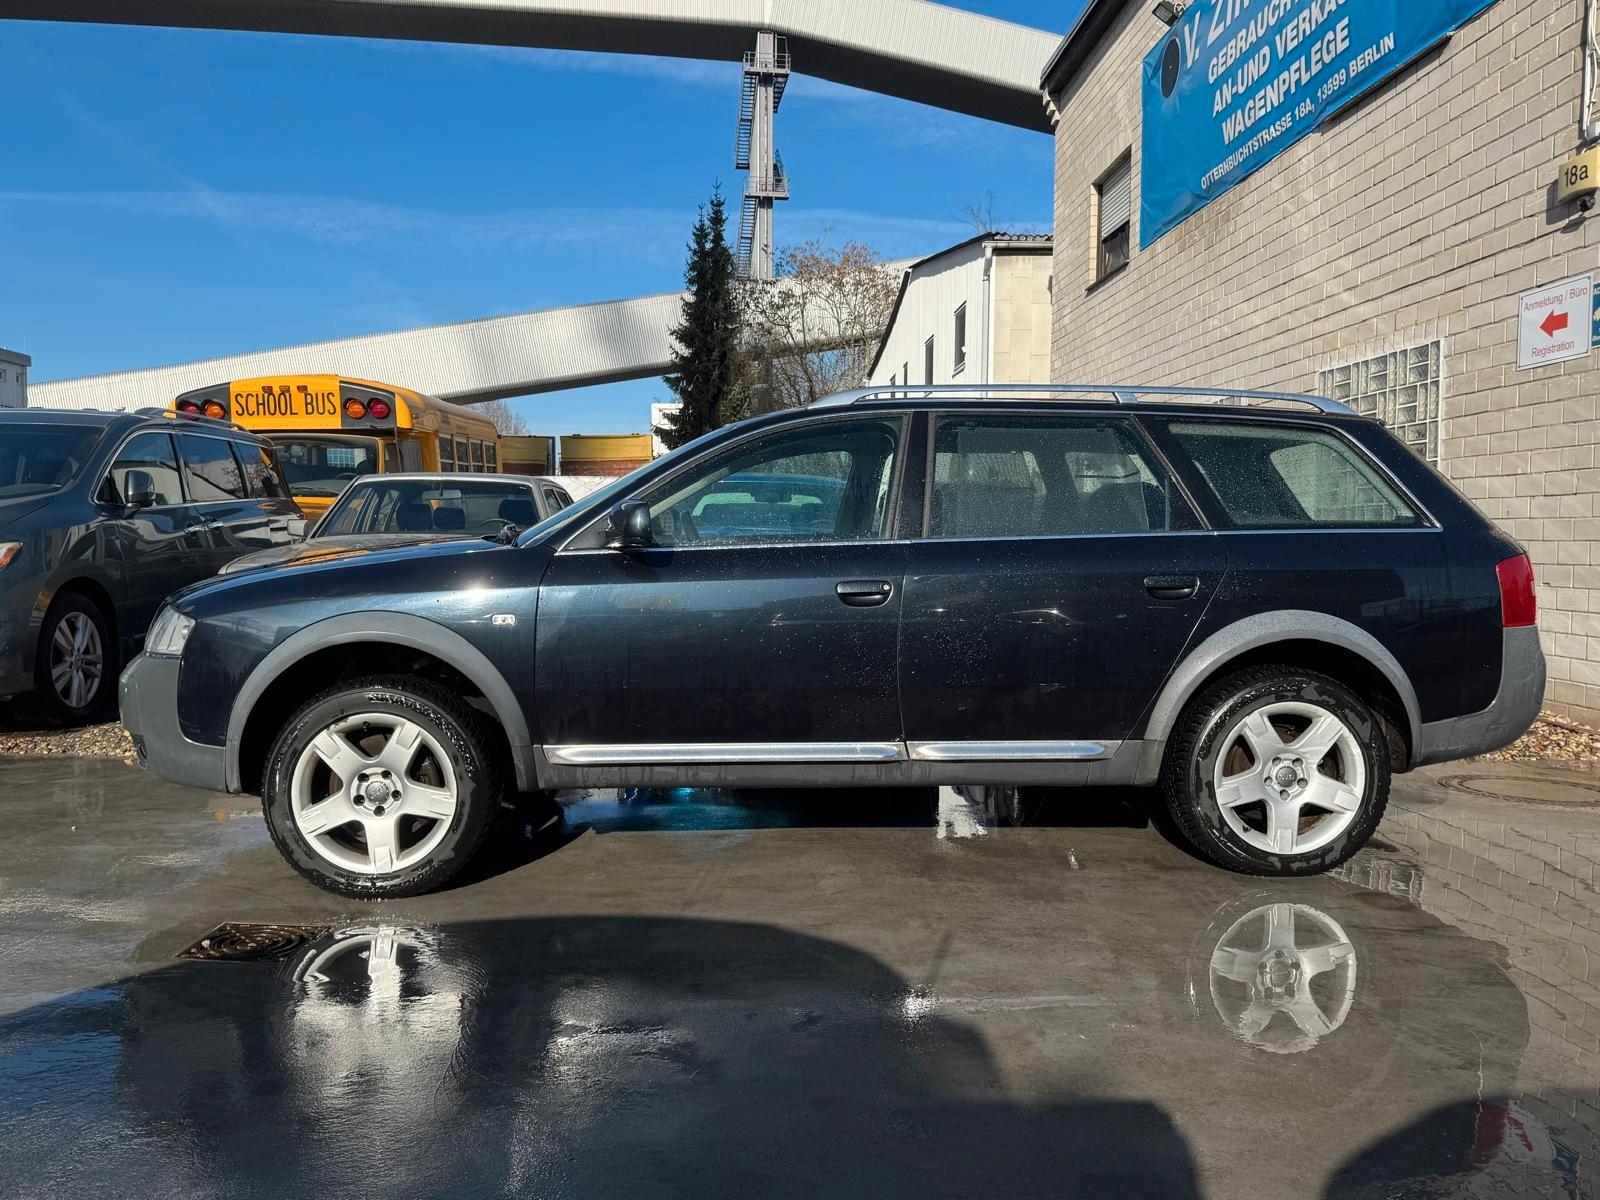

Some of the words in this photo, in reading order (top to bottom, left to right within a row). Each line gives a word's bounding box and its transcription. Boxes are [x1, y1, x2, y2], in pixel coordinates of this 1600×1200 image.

[1184, 10, 1200, 69] V.
[1208, 0, 1299, 84] GEBRAUCH
[1212, 45, 1270, 118] AN-UND
[1275, 0, 1346, 60] VERKA
[1222, 16, 1350, 145] WAGENPFLEGE
[1201, 112, 1292, 189] OTTERNBUCHTSTRASSE
[1294, 98, 1315, 121] 18A,
[1317, 68, 1346, 103] 13599
[1349, 32, 1394, 78] BERLIN
[1564, 165, 1588, 187] 18a
[1523, 294, 1563, 312] Anmeldung
[1569, 287, 1587, 299] Büro
[1531, 340, 1574, 357] Registration
[234, 392, 298, 416] SCHOOL
[304, 392, 336, 415] BUS
